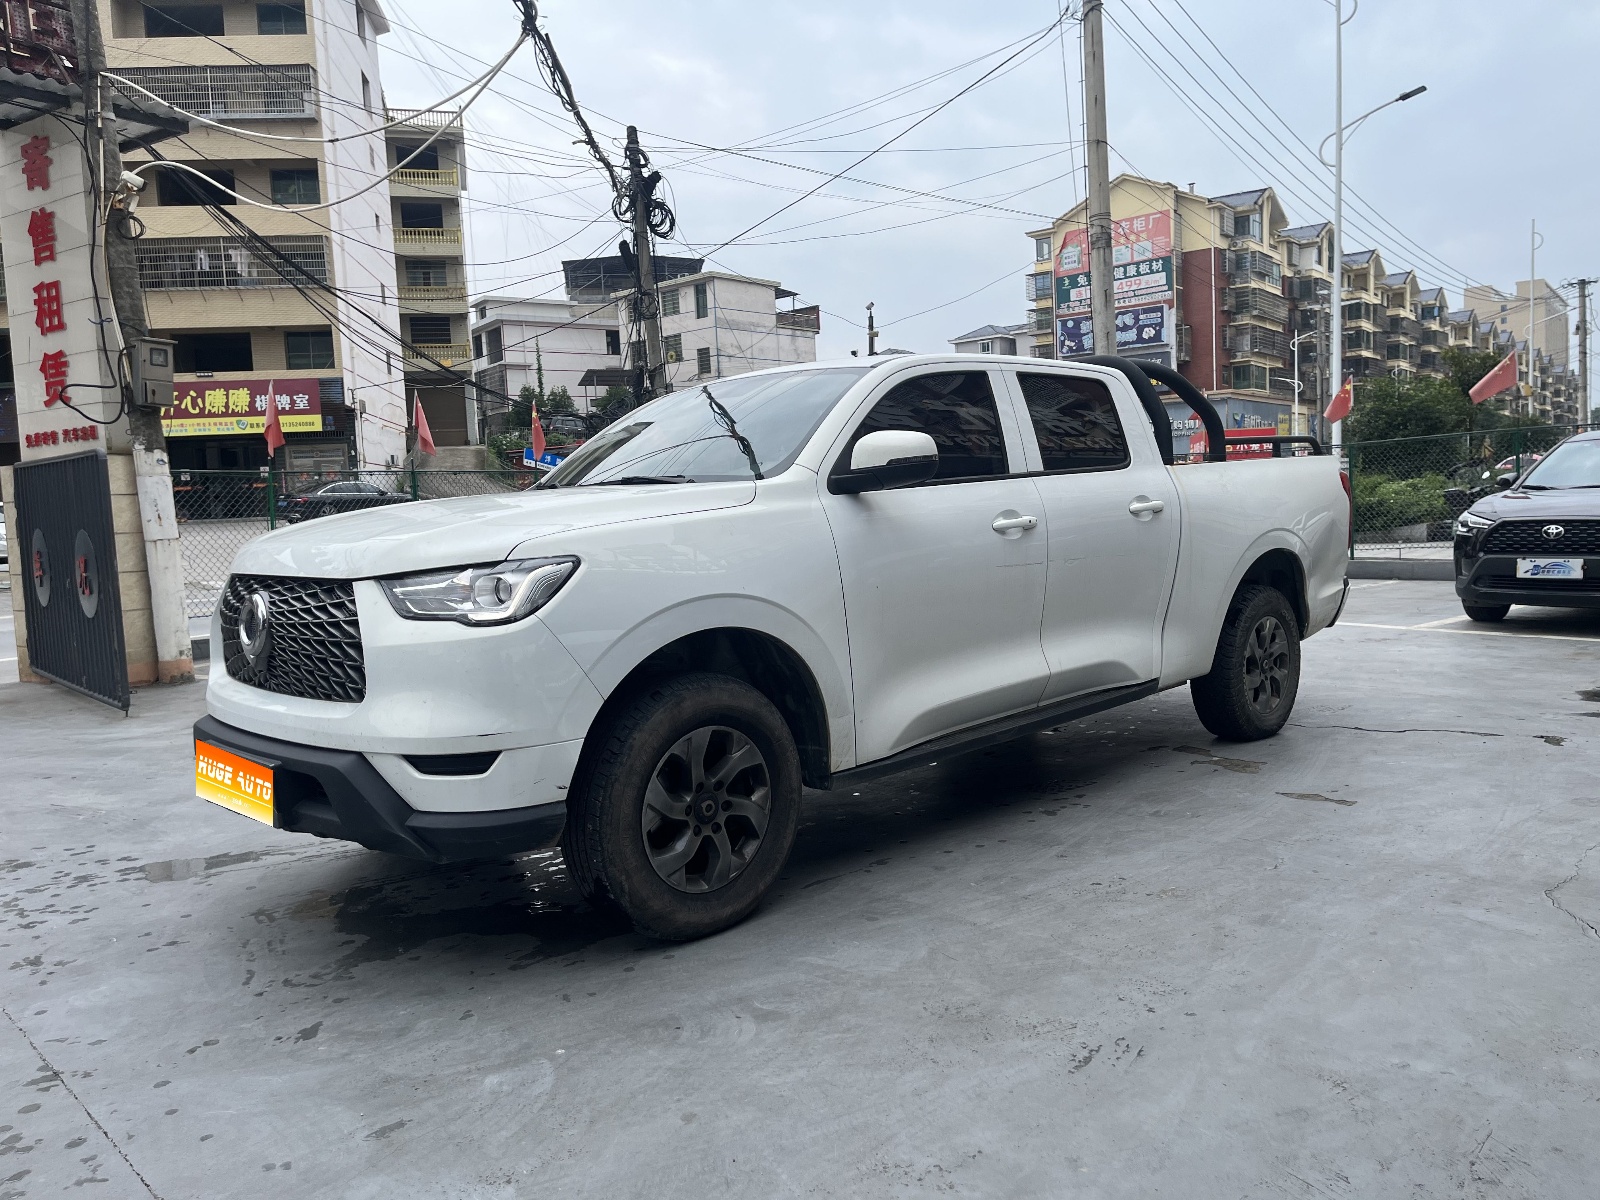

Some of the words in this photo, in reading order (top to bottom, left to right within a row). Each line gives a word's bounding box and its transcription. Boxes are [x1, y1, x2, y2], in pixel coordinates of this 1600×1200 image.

[20, 135, 72, 408] 寄售租赁
[1113, 259, 1164, 279] 健康板材
[1117, 278, 1142, 291] 499
[254, 393, 310, 411] 棋牌室
